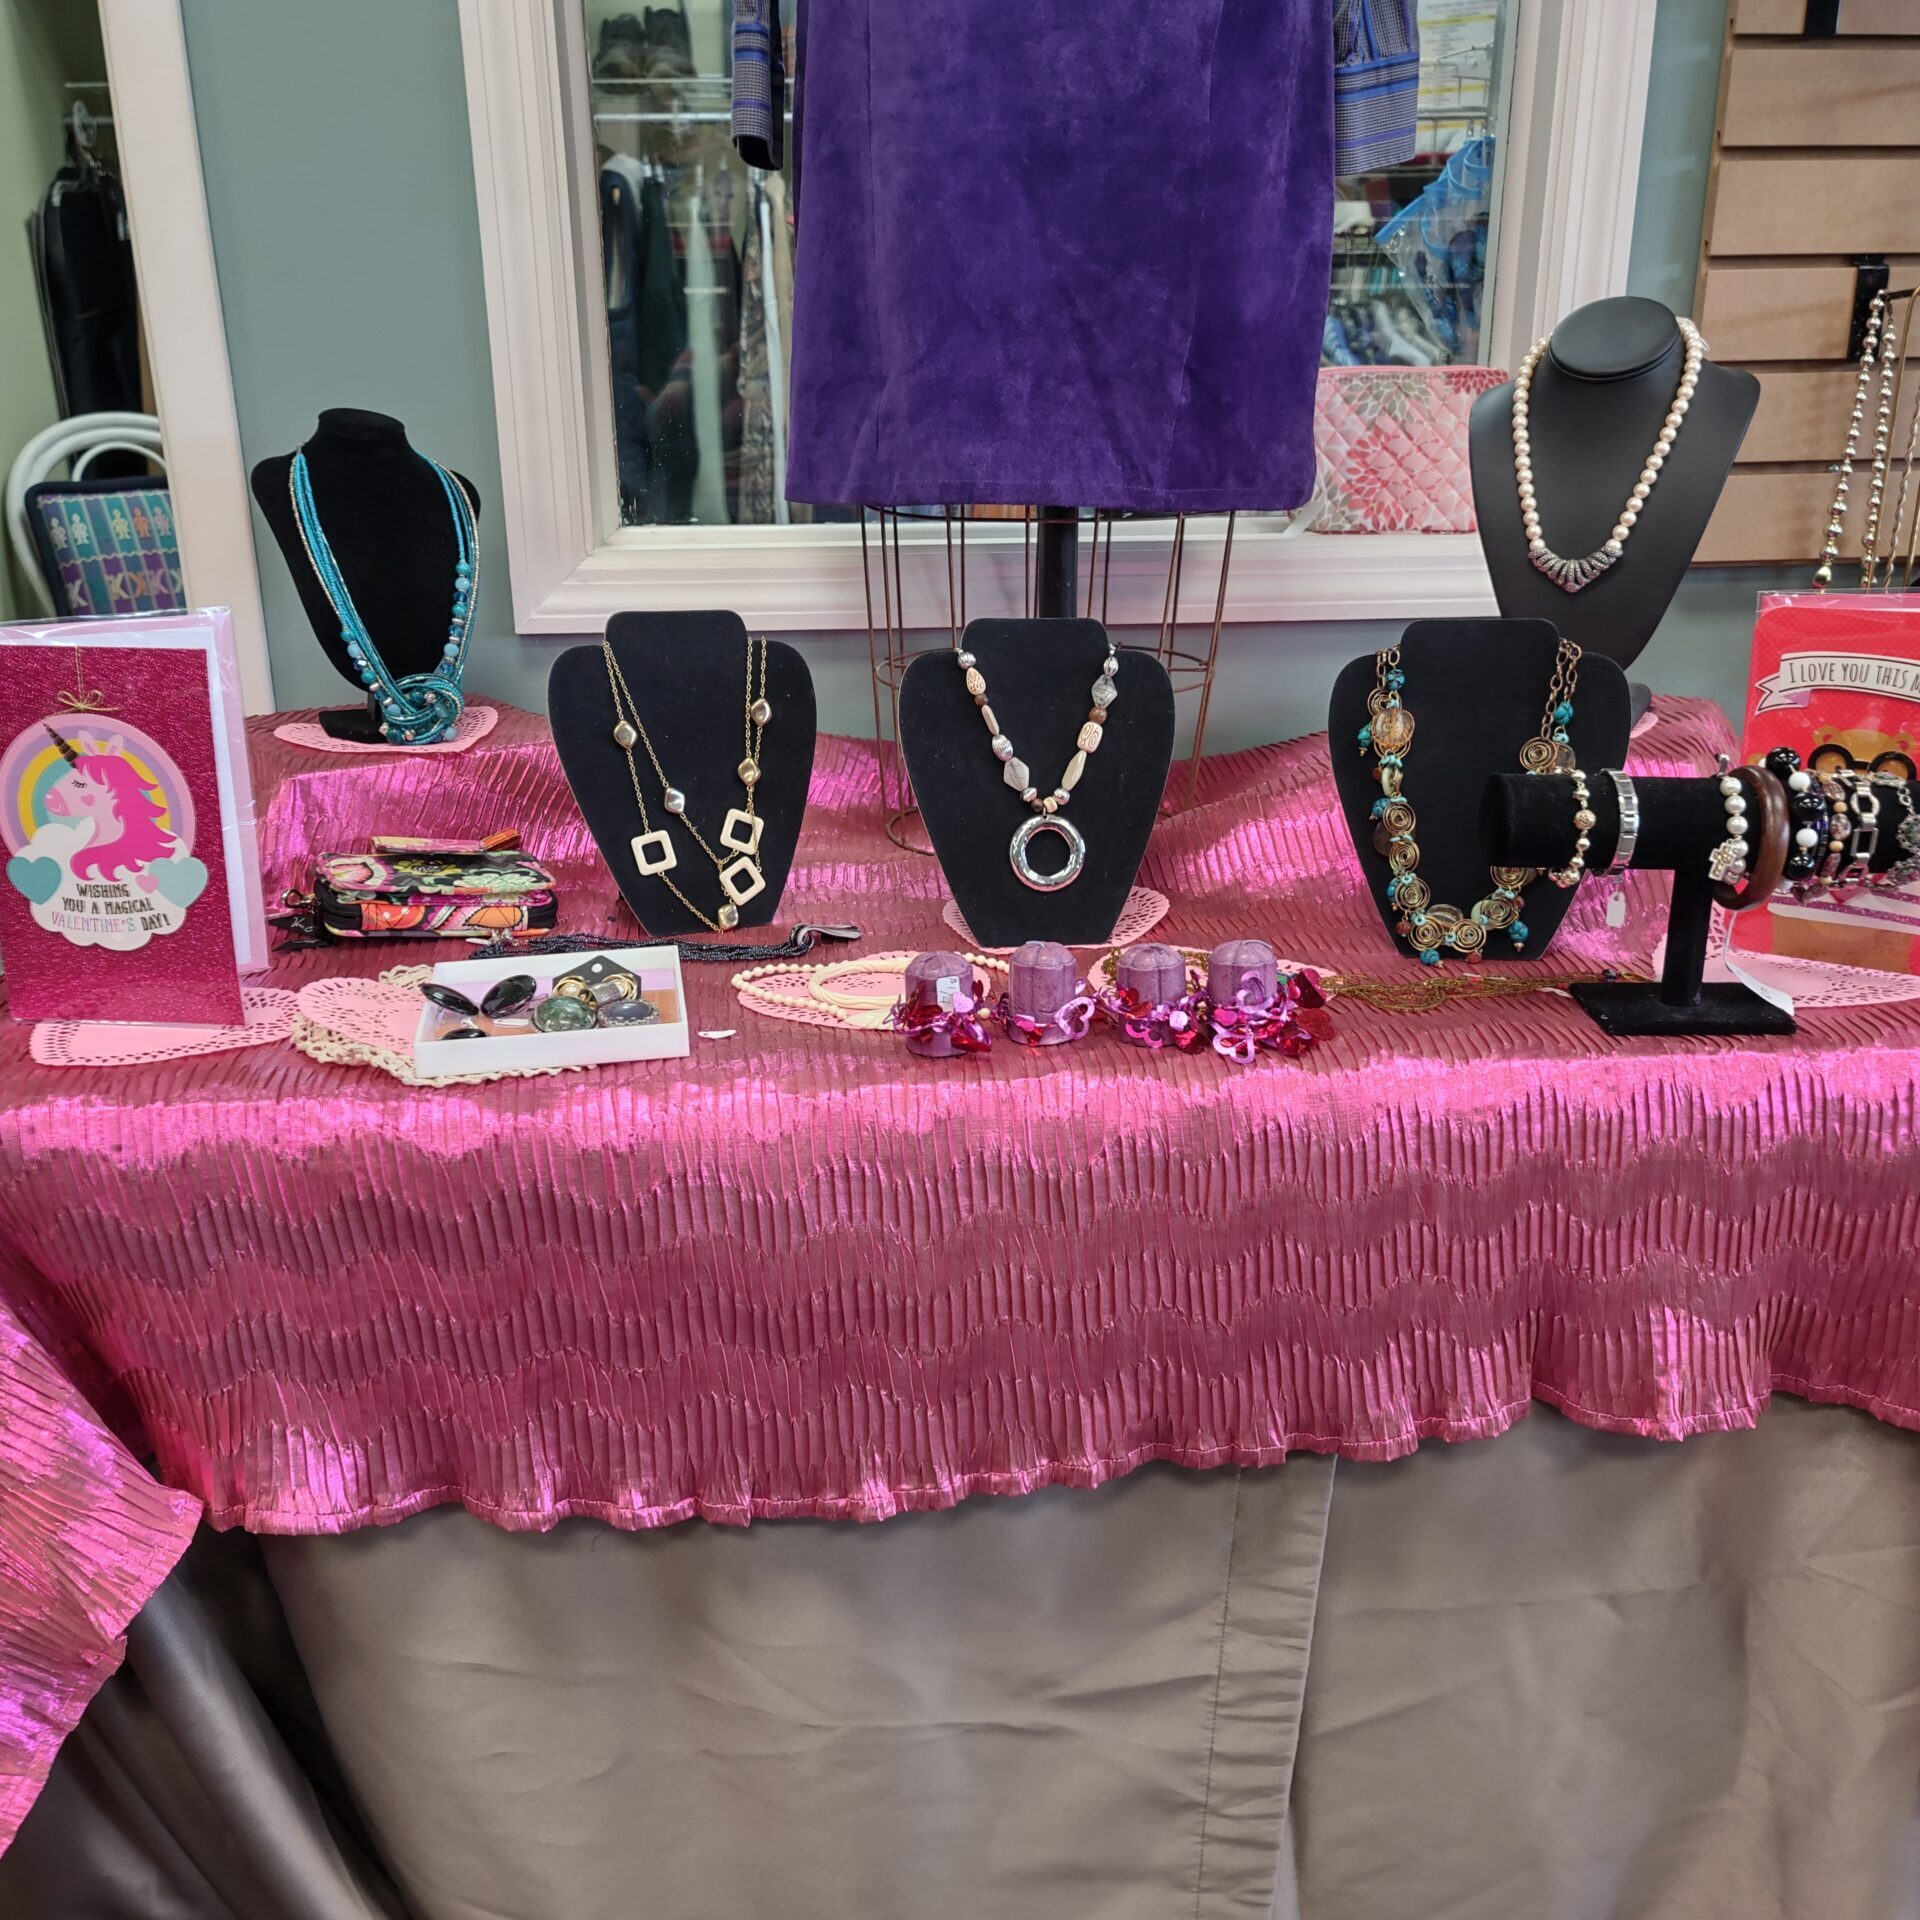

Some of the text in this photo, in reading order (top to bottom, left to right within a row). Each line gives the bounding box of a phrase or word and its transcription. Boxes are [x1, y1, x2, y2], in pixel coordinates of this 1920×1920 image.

[1788, 663, 1796, 683] I
[1800, 663, 1836, 682] LOVE
[1841, 663, 1870, 683] YOU
[1876, 665, 1909, 689] THIS
[76, 883, 131, 898] WISHING
[62, 897, 155, 915] YOU A MAGICAL
[51, 911, 171, 933] VALENTINE'S DAY!
